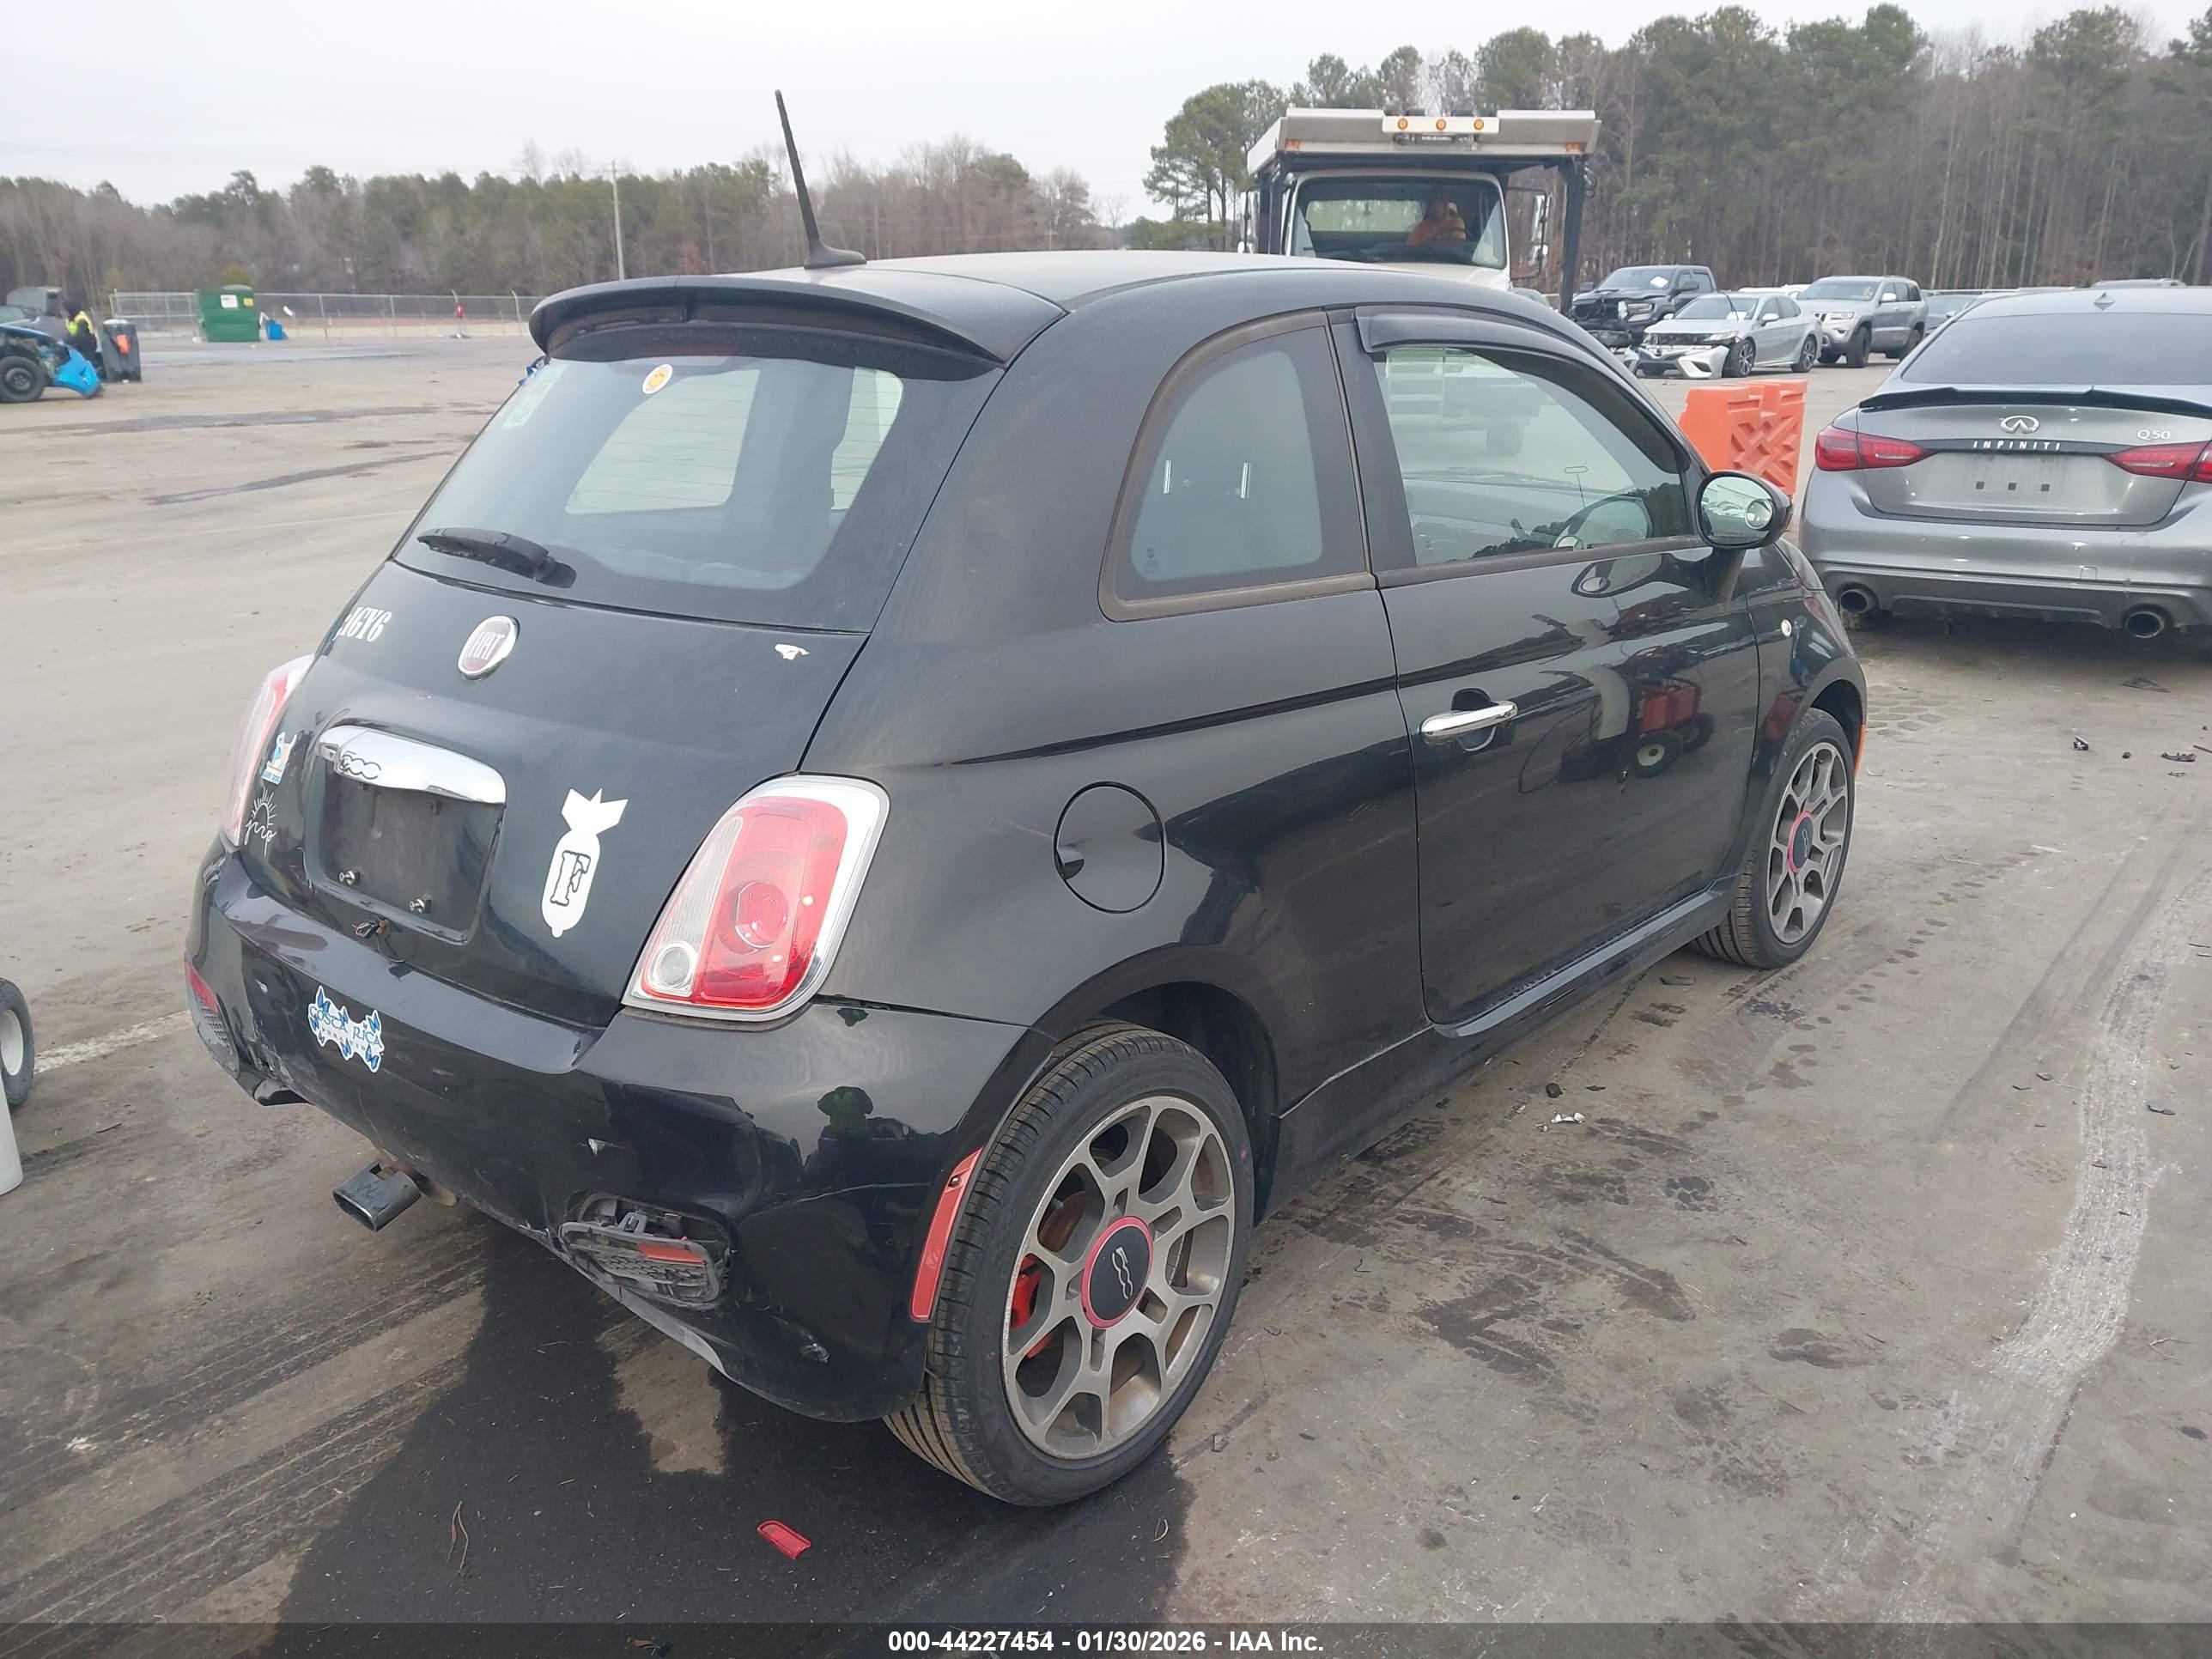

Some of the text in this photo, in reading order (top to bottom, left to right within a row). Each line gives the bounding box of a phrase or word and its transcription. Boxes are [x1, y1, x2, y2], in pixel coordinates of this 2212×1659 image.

[1973, 440, 2061, 451] INFINITI
[2137, 429, 2172, 441] Q50
[468, 631, 505, 660] FIAT
[340, 750, 382, 780] 500
[550, 850, 591, 907] F
[1112, 1247, 1133, 1300] 500
